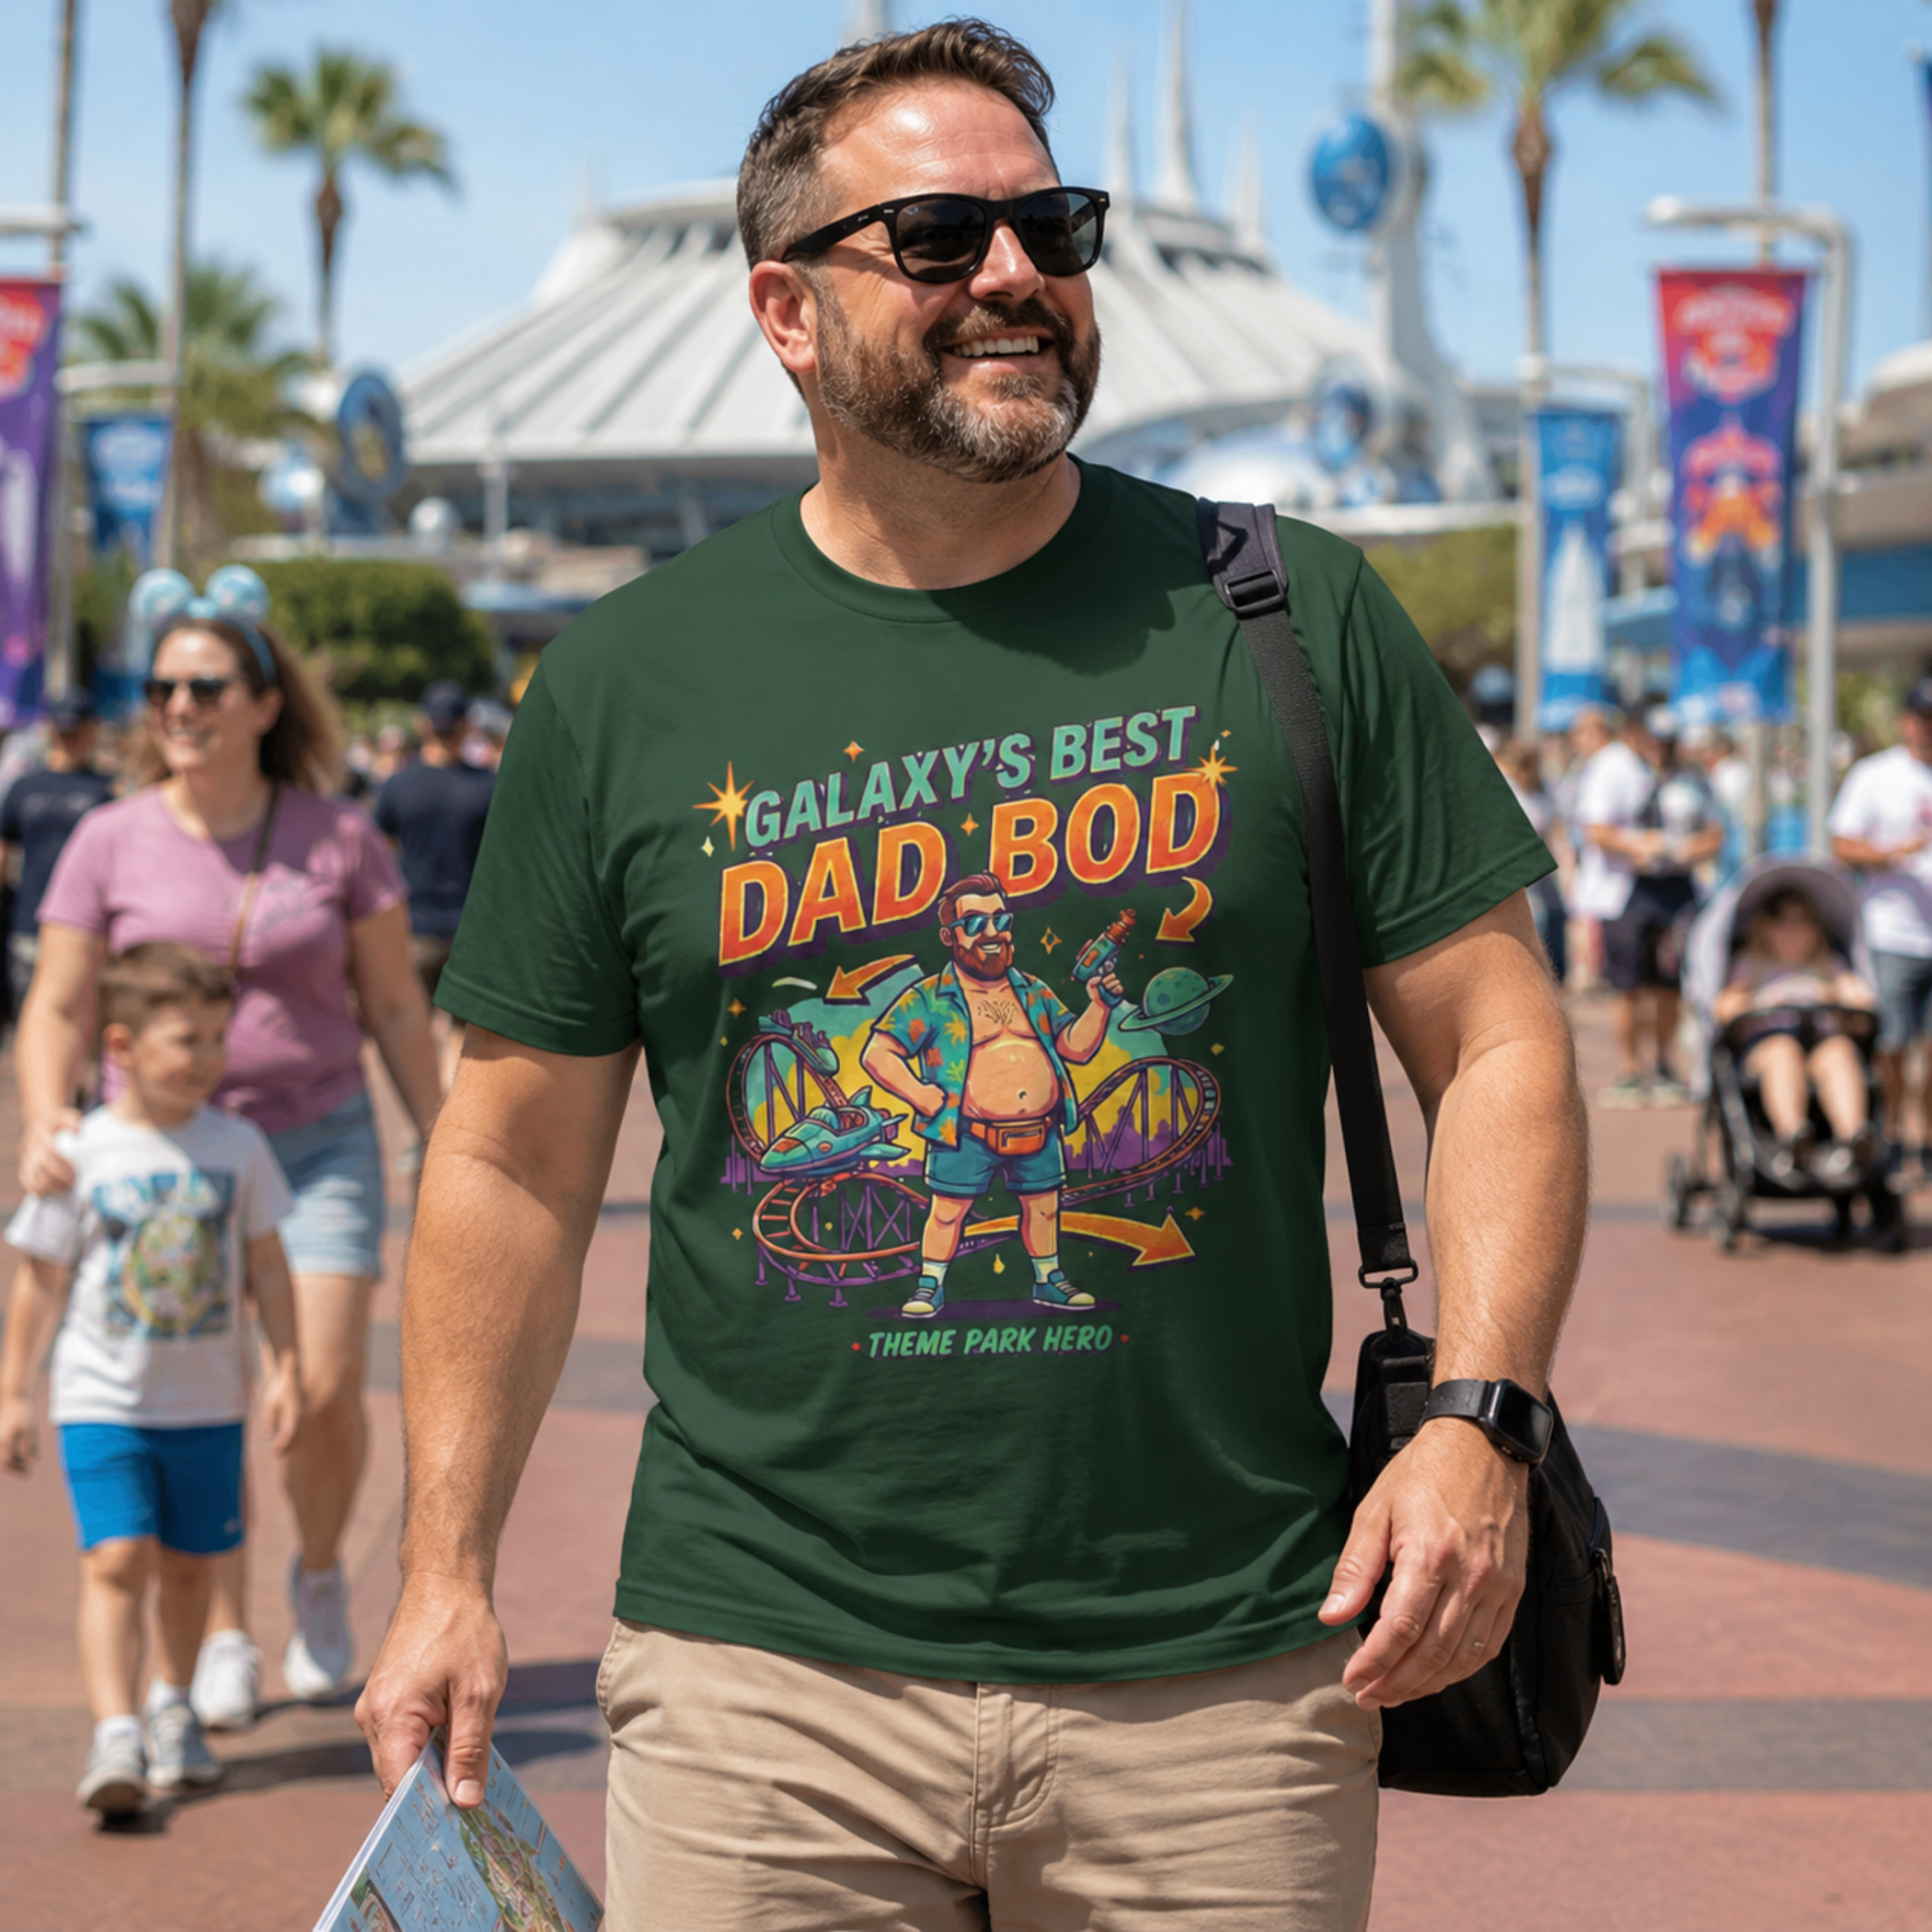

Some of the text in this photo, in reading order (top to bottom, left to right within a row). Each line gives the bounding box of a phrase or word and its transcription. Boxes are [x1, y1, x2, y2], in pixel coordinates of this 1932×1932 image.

[743, 706, 1197, 847] GALAXY'S BEST
[719, 772, 1221, 966] DAD BOD
[869, 1325, 1113, 1358] THEME PARK HERO
